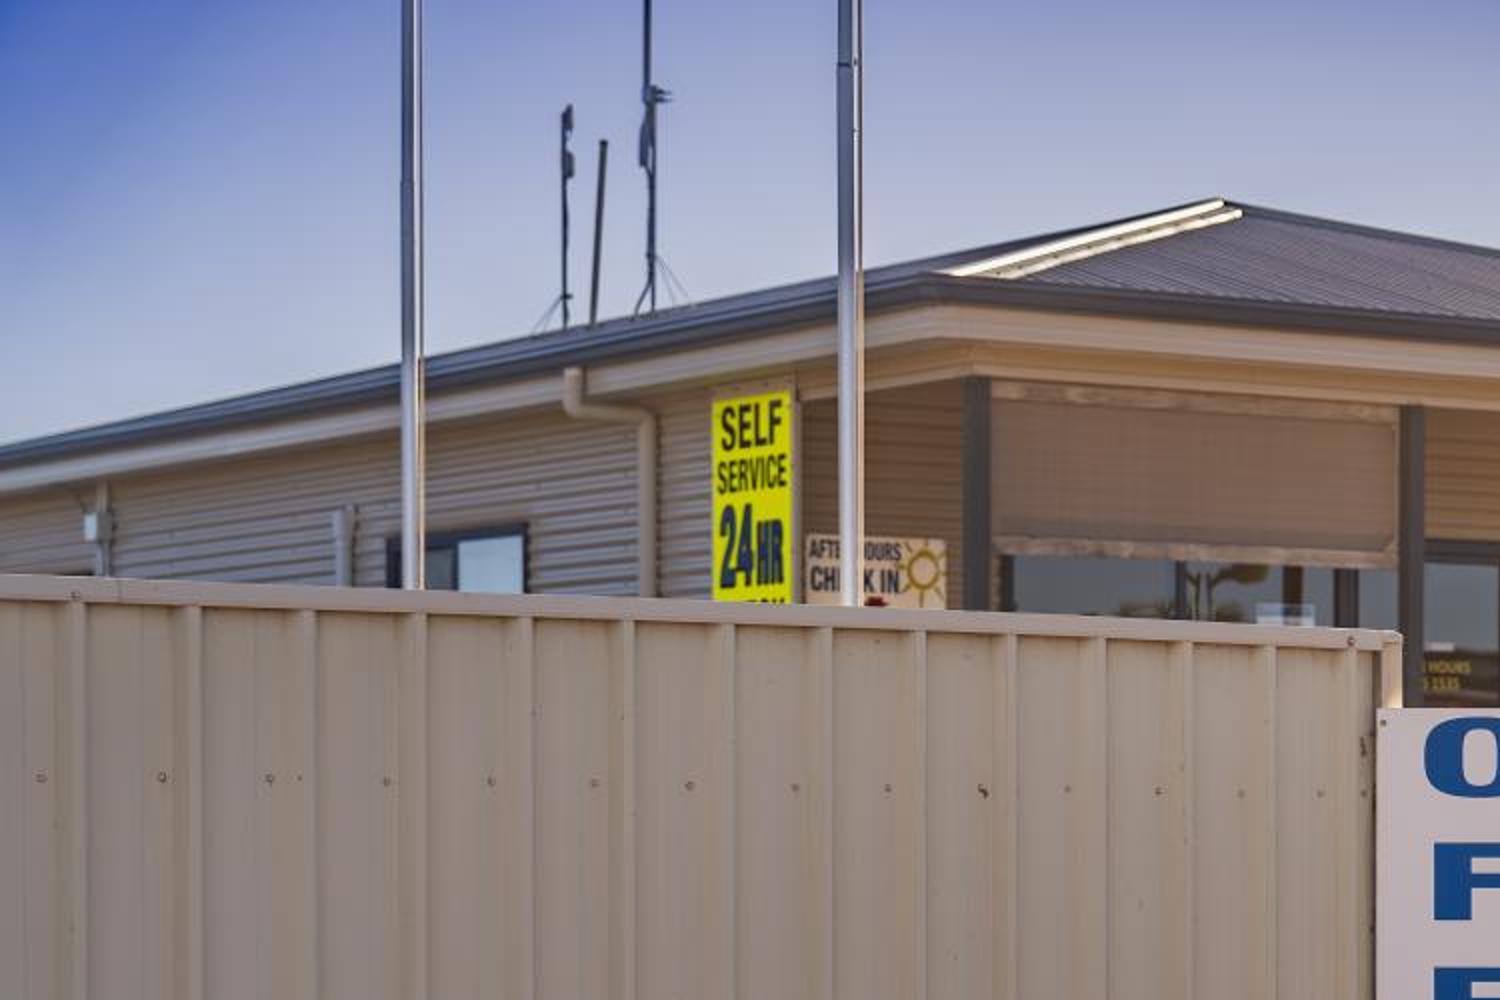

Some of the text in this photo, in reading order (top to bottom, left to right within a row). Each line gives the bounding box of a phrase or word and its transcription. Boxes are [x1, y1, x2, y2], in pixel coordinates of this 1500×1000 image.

[721, 399, 782, 452] SELF
[717, 453, 786, 495] SERVICE
[809, 539, 841, 560] AFTE
[810, 565, 899, 593] CHK IN
